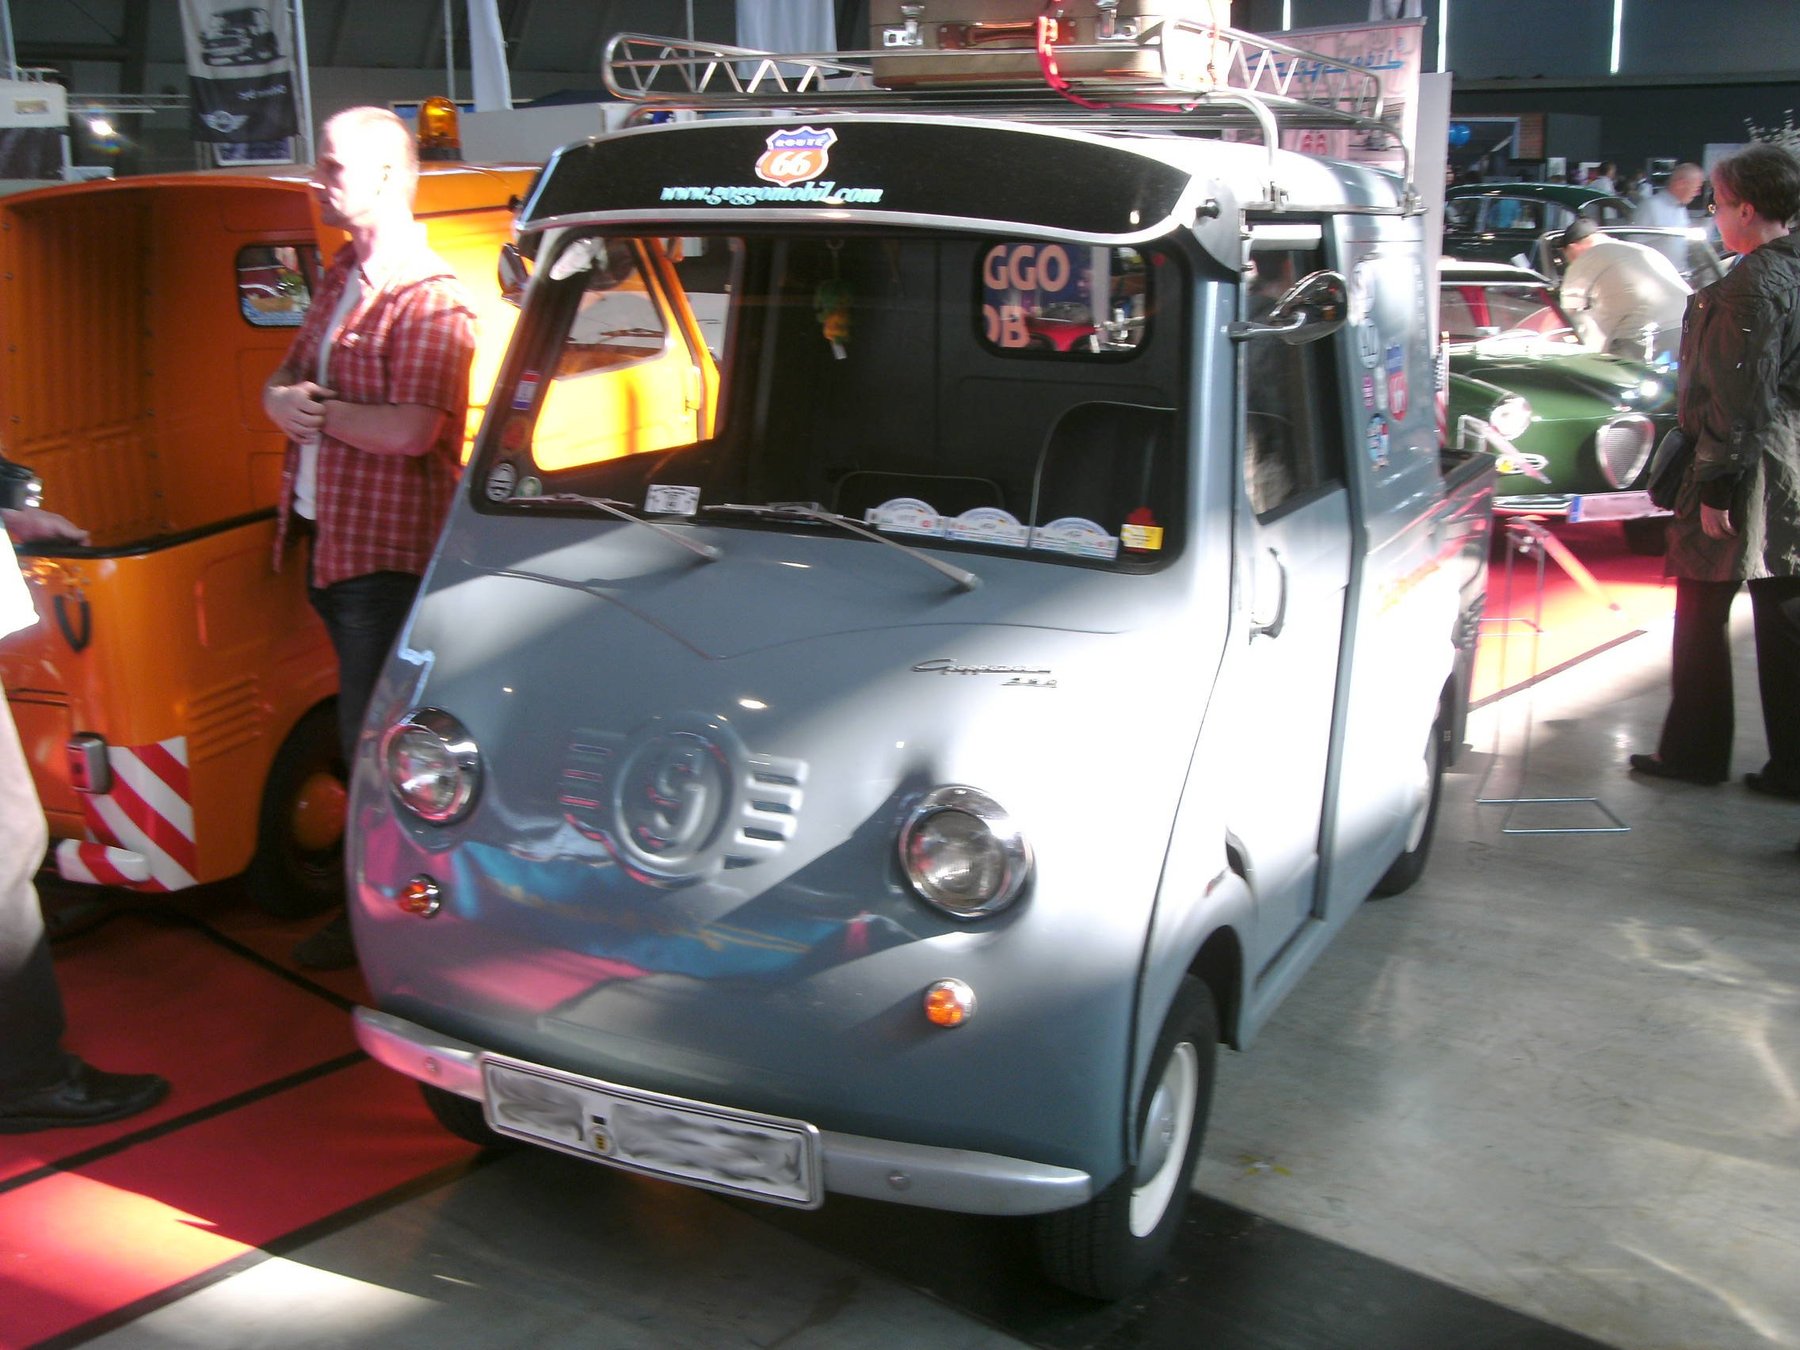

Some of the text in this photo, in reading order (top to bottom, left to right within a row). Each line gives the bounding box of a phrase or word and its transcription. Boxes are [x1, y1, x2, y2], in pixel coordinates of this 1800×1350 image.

[775, 138, 826, 148] ROUTE
[769, 151, 813, 177] 66
[660, 181, 884, 206] www.goggomobil.com
